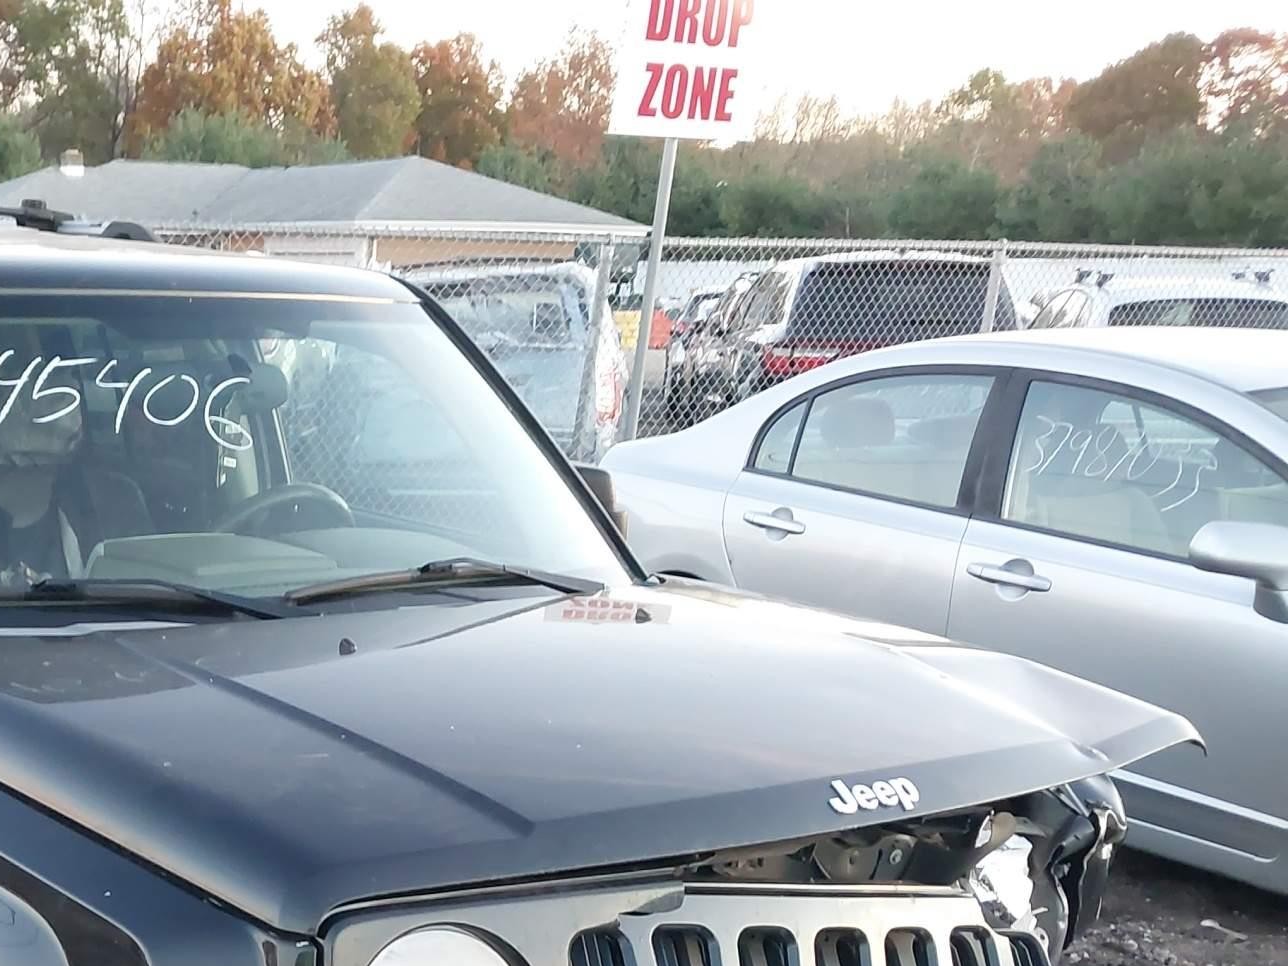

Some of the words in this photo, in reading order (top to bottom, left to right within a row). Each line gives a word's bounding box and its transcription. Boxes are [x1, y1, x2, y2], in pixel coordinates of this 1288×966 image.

[646, 0, 754, 47] DROP
[638, 62, 738, 121] ZONE
[828, 777, 920, 814] Jeep
